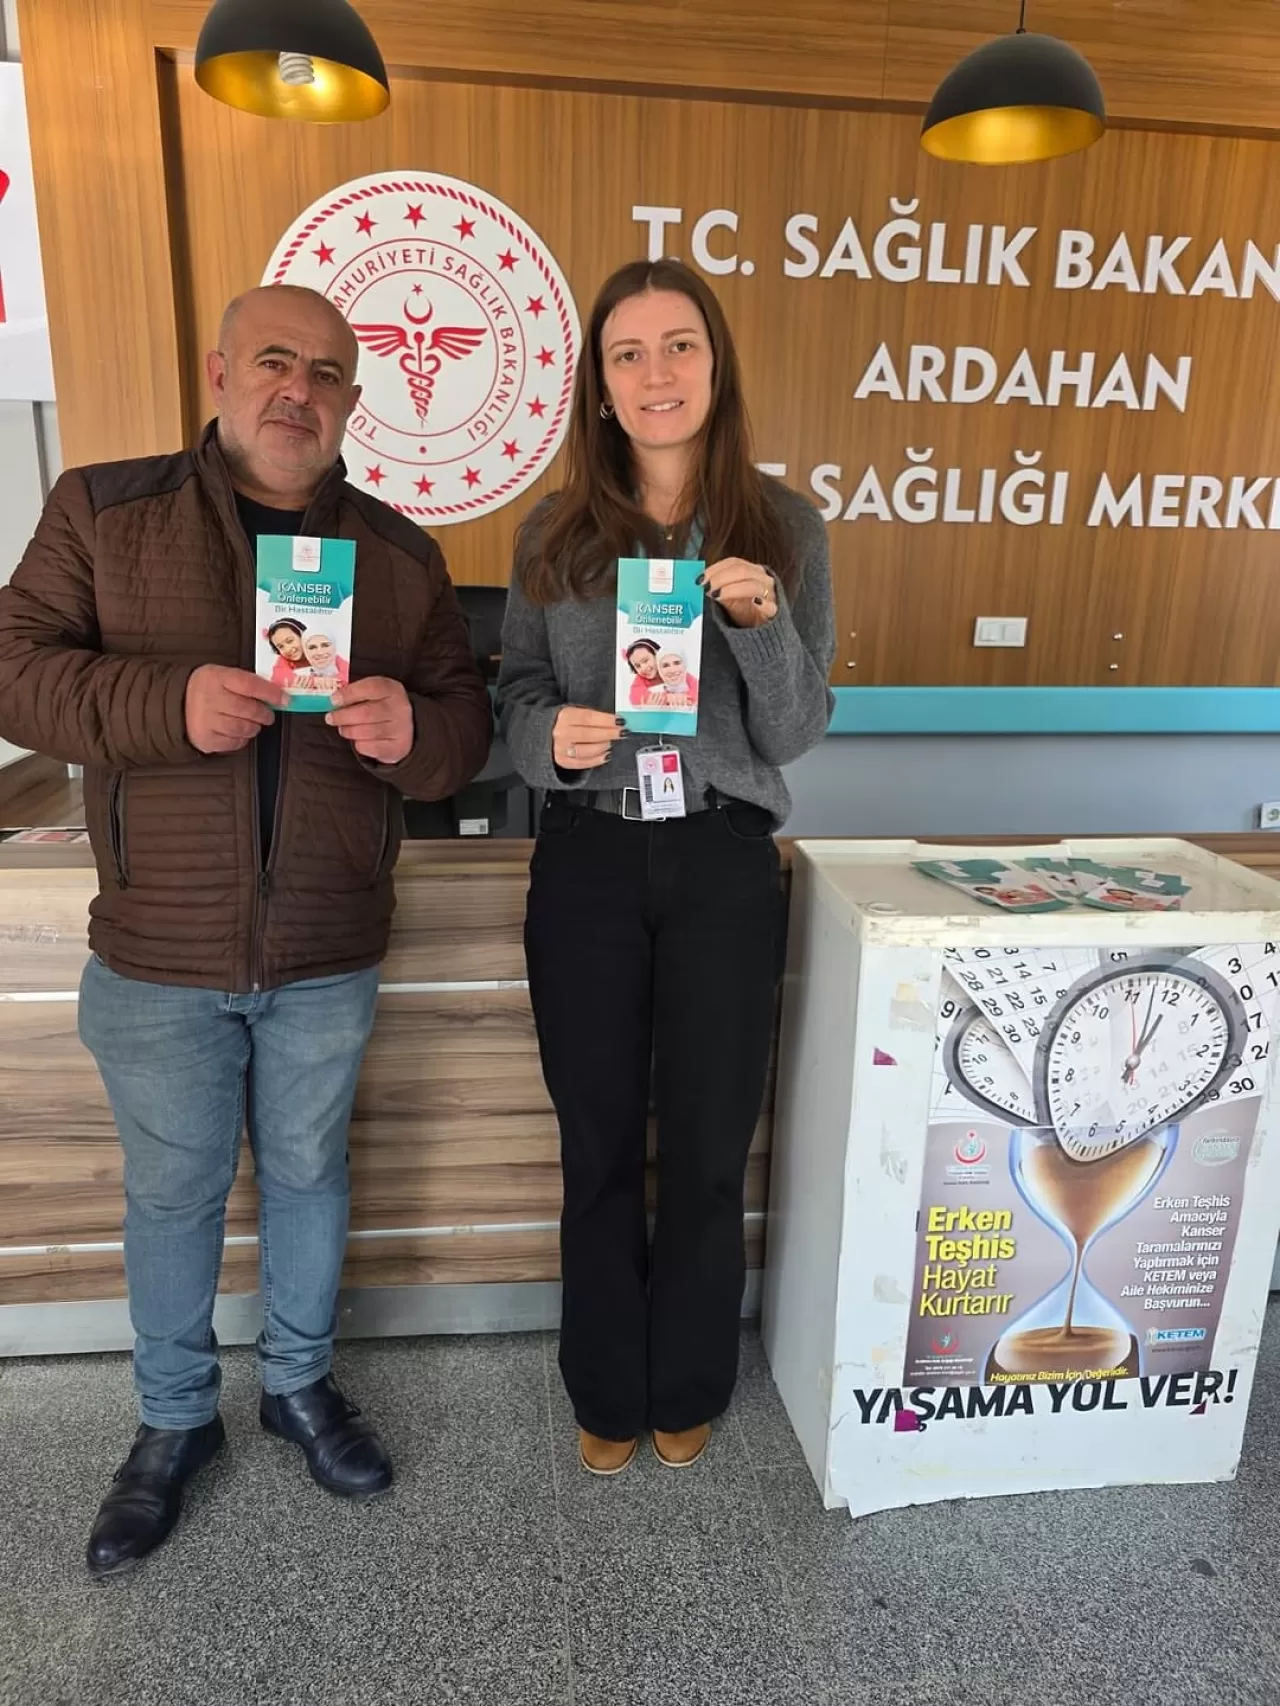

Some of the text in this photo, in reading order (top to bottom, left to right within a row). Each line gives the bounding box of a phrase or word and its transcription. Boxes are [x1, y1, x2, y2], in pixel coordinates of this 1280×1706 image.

[783, 197, 1038, 287] SAĞLIK
[442, 255, 508, 321] SAĞLIK
[466, 326, 518, 442] BAKANLIĞI
[853, 341, 1192, 413] ARDAHAN
[810, 447, 1068, 526] SAĞLIĞI
[277, 582, 332, 594] KANSER
[636, 602, 684, 615] KANSER
[1013, 961, 1032, 980] 14
[1042, 962, 1057, 972] 7
[1228, 957, 1242, 975] 3
[959, 970, 985, 992] 28
[986, 967, 1009, 985] 21
[1004, 991, 1025, 1011] 22
[1030, 986, 1048, 1006] 15
[1055, 988, 1068, 1000] 8
[1124, 989, 1140, 1005] 11
[1161, 989, 1181, 1007] 12
[981, 997, 1004, 1017] 29
[1092, 1004, 1109, 1020] 10
[1021, 1016, 1041, 1038] 23
[1190, 1013, 1200, 1027] 1
[1002, 1023, 1022, 1043] 30
[1070, 1031, 1081, 1045] 9
[1196, 1044, 1210, 1058] 2
[1064, 1067, 1075, 1083] 8
[1228, 1077, 1255, 1095] 30
[1088, 1122, 1099, 1138] 6
[1154, 1194, 1231, 1210] Erken Teşhis
[927, 1206, 1012, 1232] Erken
[1170, 1210, 1228, 1224] Amacıyla
[1181, 1225, 1226, 1238] Kanser
[925, 1233, 1016, 1268] Teşhis
[922, 1263, 998, 1294] Hayat
[1144, 1270, 1217, 1282] KETEM veya
[1120, 1285, 1144, 1297] Aile
[919, 1292, 1014, 1317] Kurtarır
[1157, 1329, 1205, 1340] KETEM
[853, 1370, 1239, 1433] YAŞAMA YOL VER!
